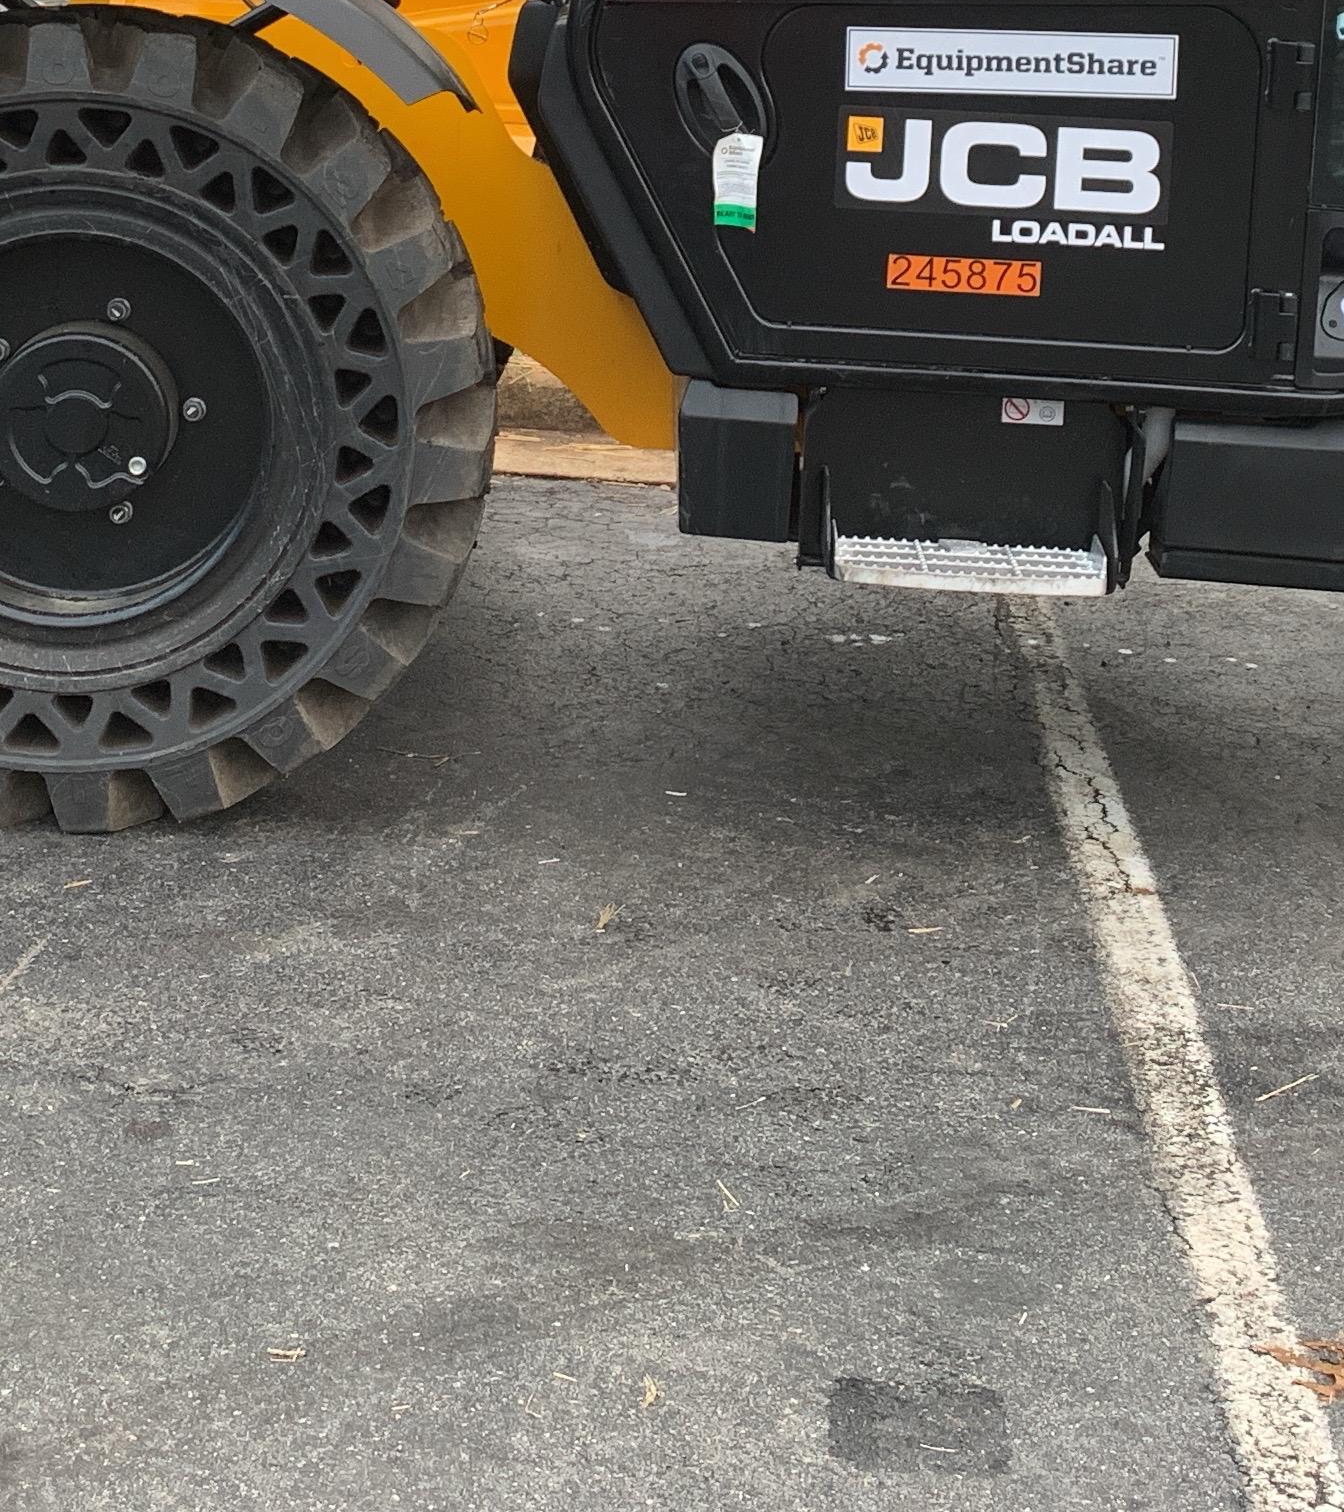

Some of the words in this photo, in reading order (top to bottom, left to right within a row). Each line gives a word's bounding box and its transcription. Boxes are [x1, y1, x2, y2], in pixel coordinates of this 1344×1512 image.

[895, 47, 1157, 77] EquipmentShare
[844, 118, 1161, 214] JCB
[991, 219, 1166, 251] LOADALL
[890, 255, 1038, 293] 245875
